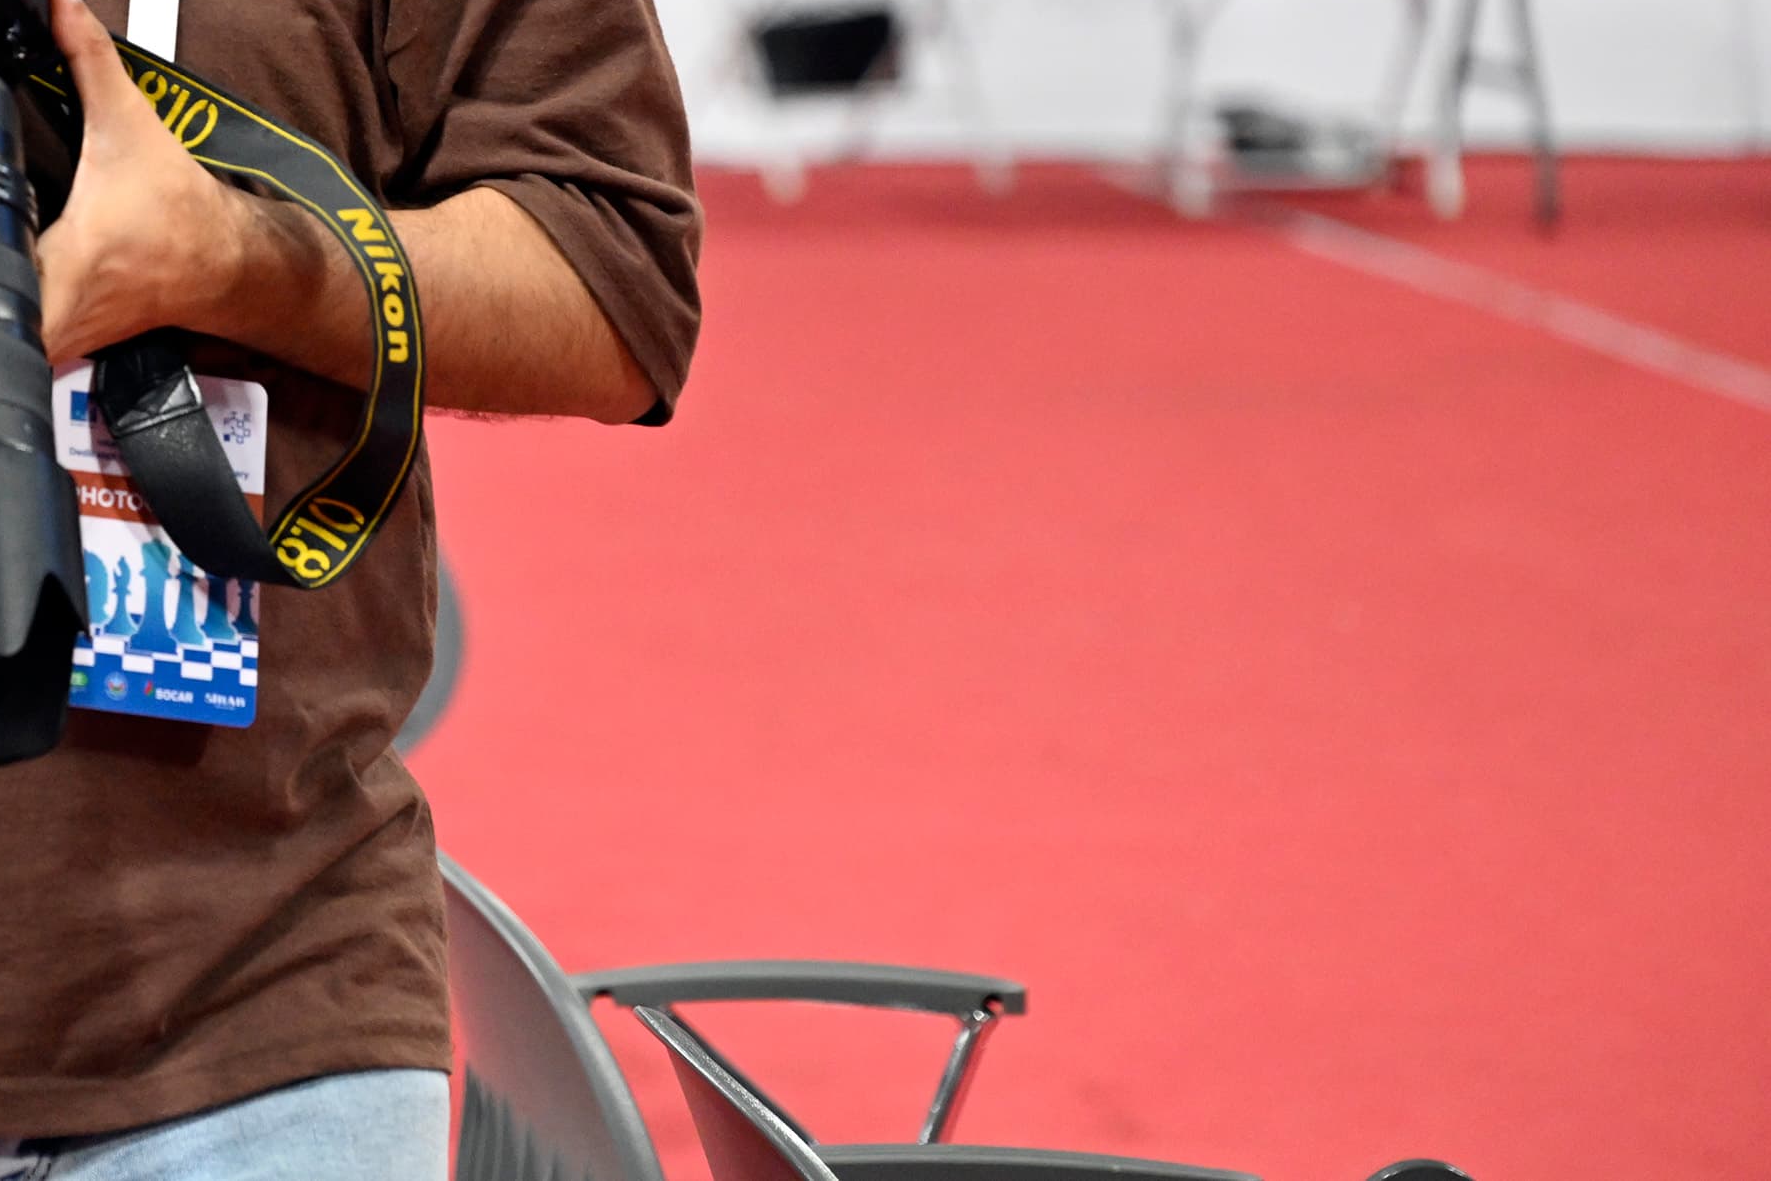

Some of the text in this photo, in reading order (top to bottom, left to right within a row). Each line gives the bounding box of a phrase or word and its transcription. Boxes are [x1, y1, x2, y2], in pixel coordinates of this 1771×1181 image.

[336, 208, 410, 363] Nikon
[76, 485, 150, 512] HOTO
[155, 687, 194, 704] SOCAR
